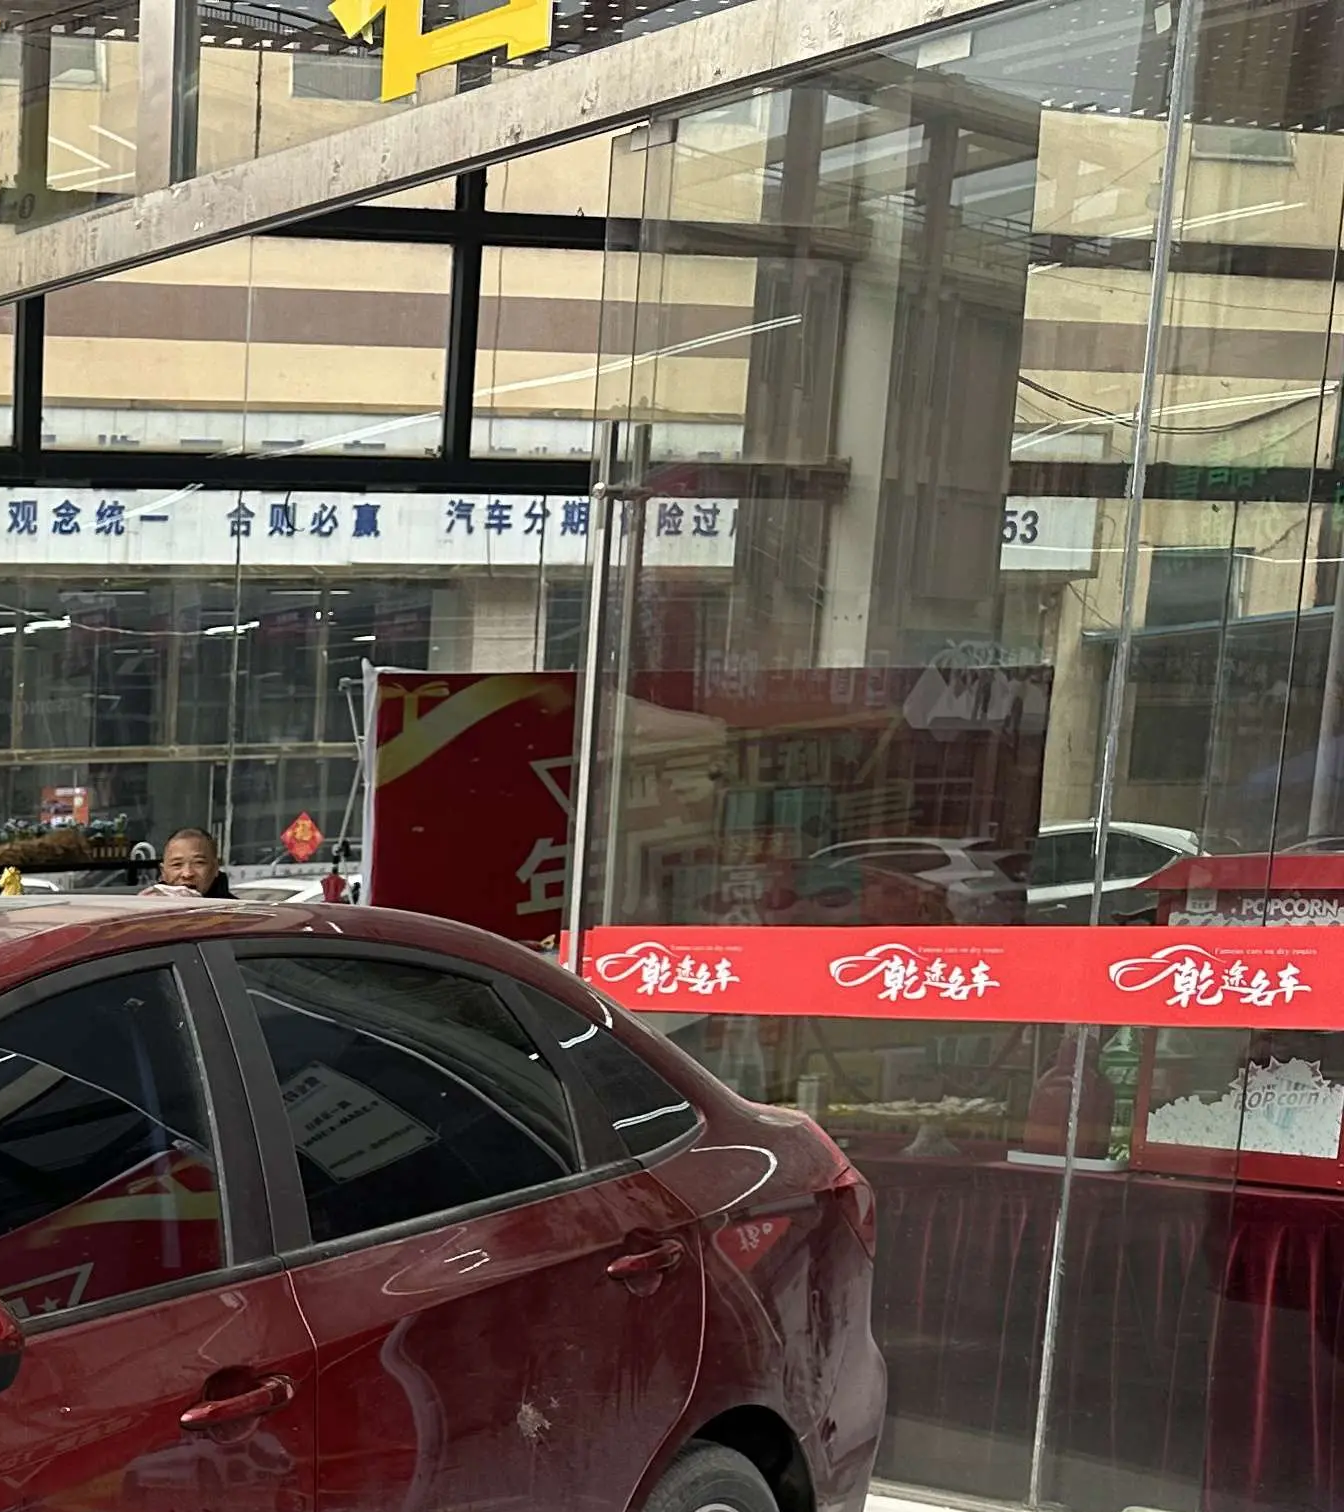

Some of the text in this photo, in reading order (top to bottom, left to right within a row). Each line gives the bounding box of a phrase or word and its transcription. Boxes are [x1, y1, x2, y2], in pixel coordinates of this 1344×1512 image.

[7, 498, 739, 539] 观念统一 合则必赢 汽车分期 险过
[1241, 898, 1340, 918] POPCORN
[636, 951, 740, 996] 乾途名车
[877, 954, 1001, 1002] 乾途名车
[1166, 956, 1312, 1008] 乾途名车
